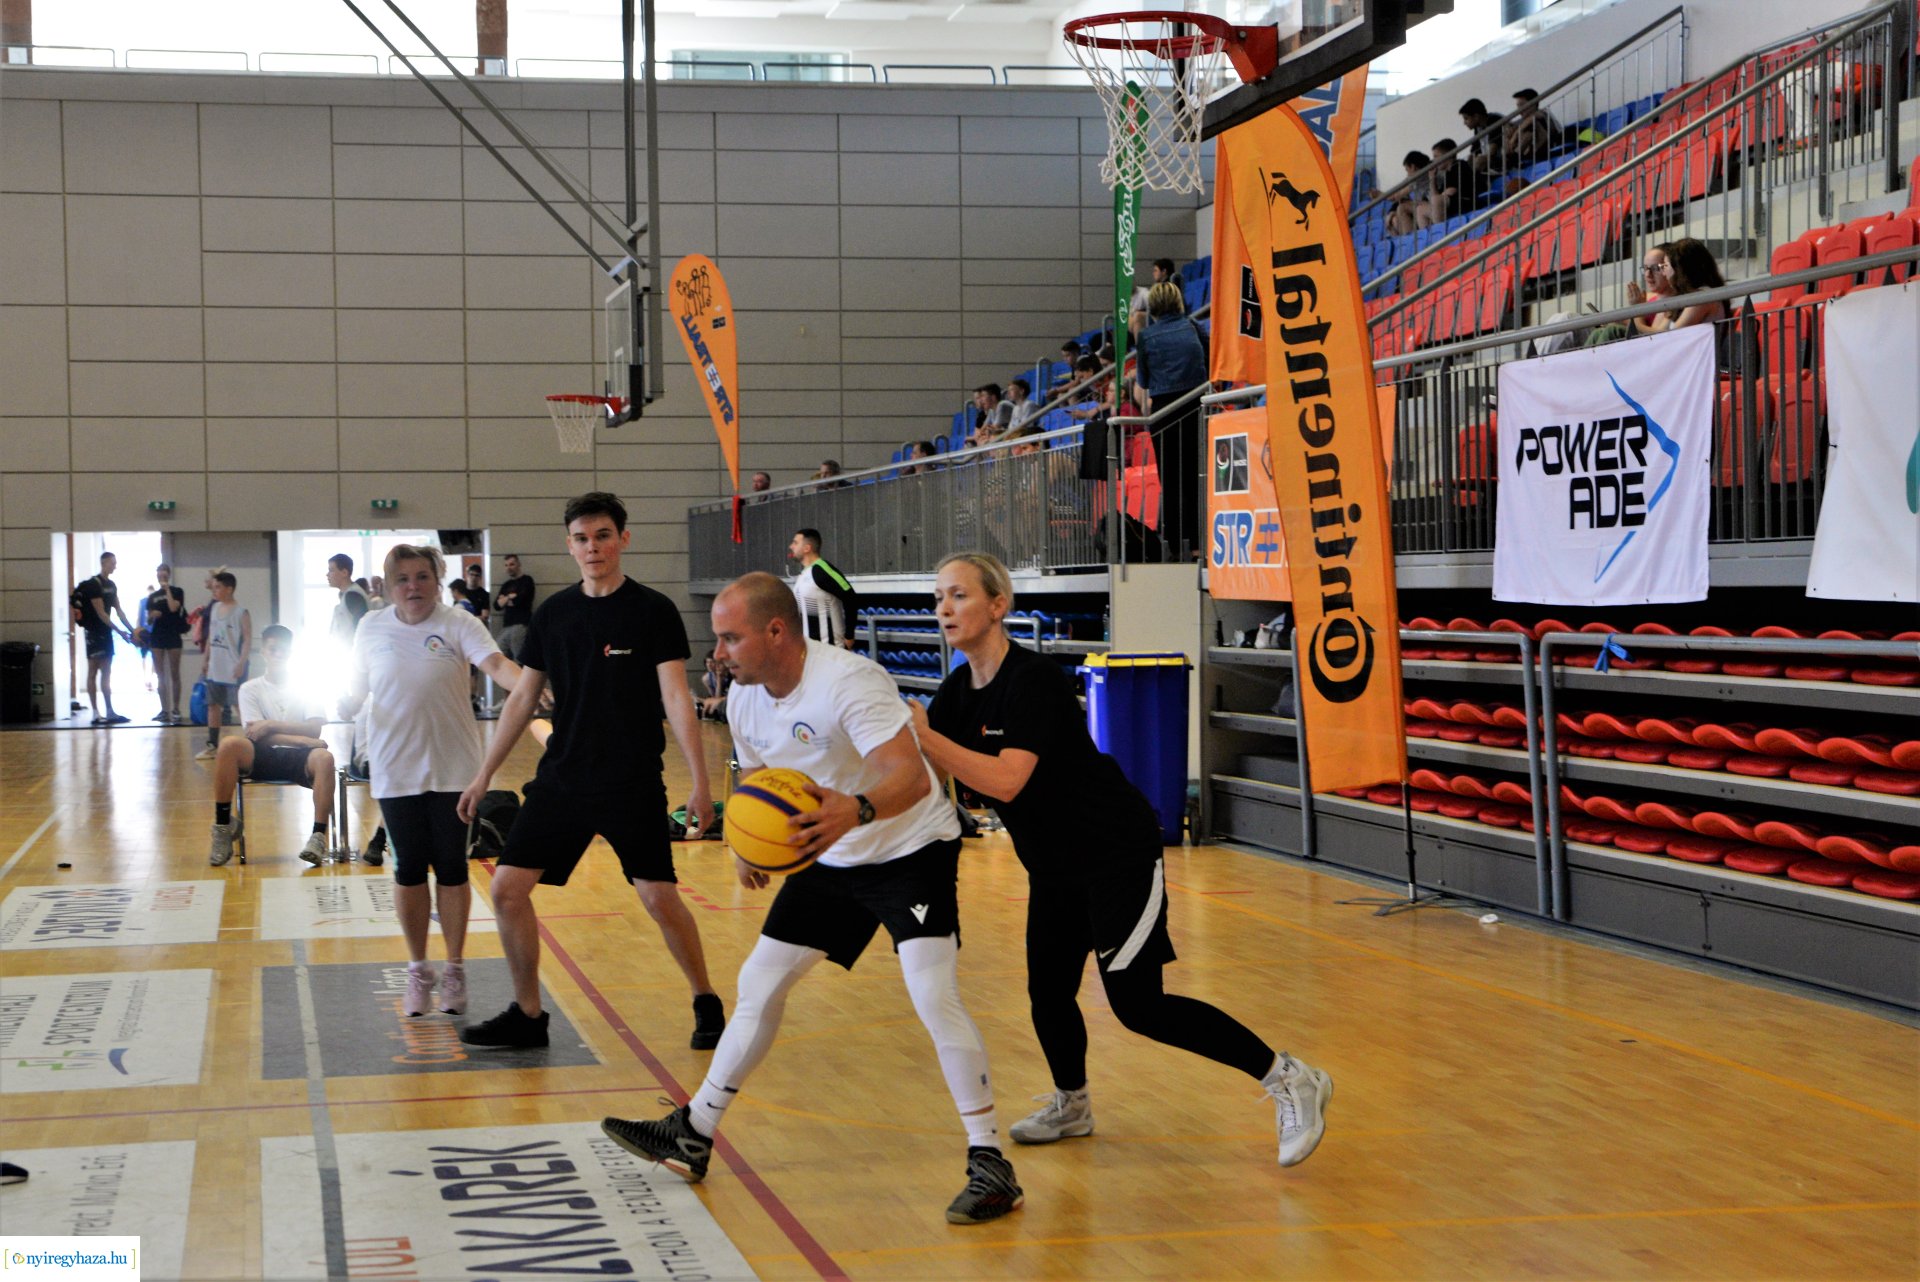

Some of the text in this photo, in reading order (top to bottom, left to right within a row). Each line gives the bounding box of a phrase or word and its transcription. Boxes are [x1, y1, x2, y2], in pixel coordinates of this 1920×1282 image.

[1516, 414, 1648, 476] POWER
[1569, 471, 1647, 530] ADE
[42, 980, 113, 1045] SPORTCENTRUM
[388, 1140, 638, 1282] AKARÉK
